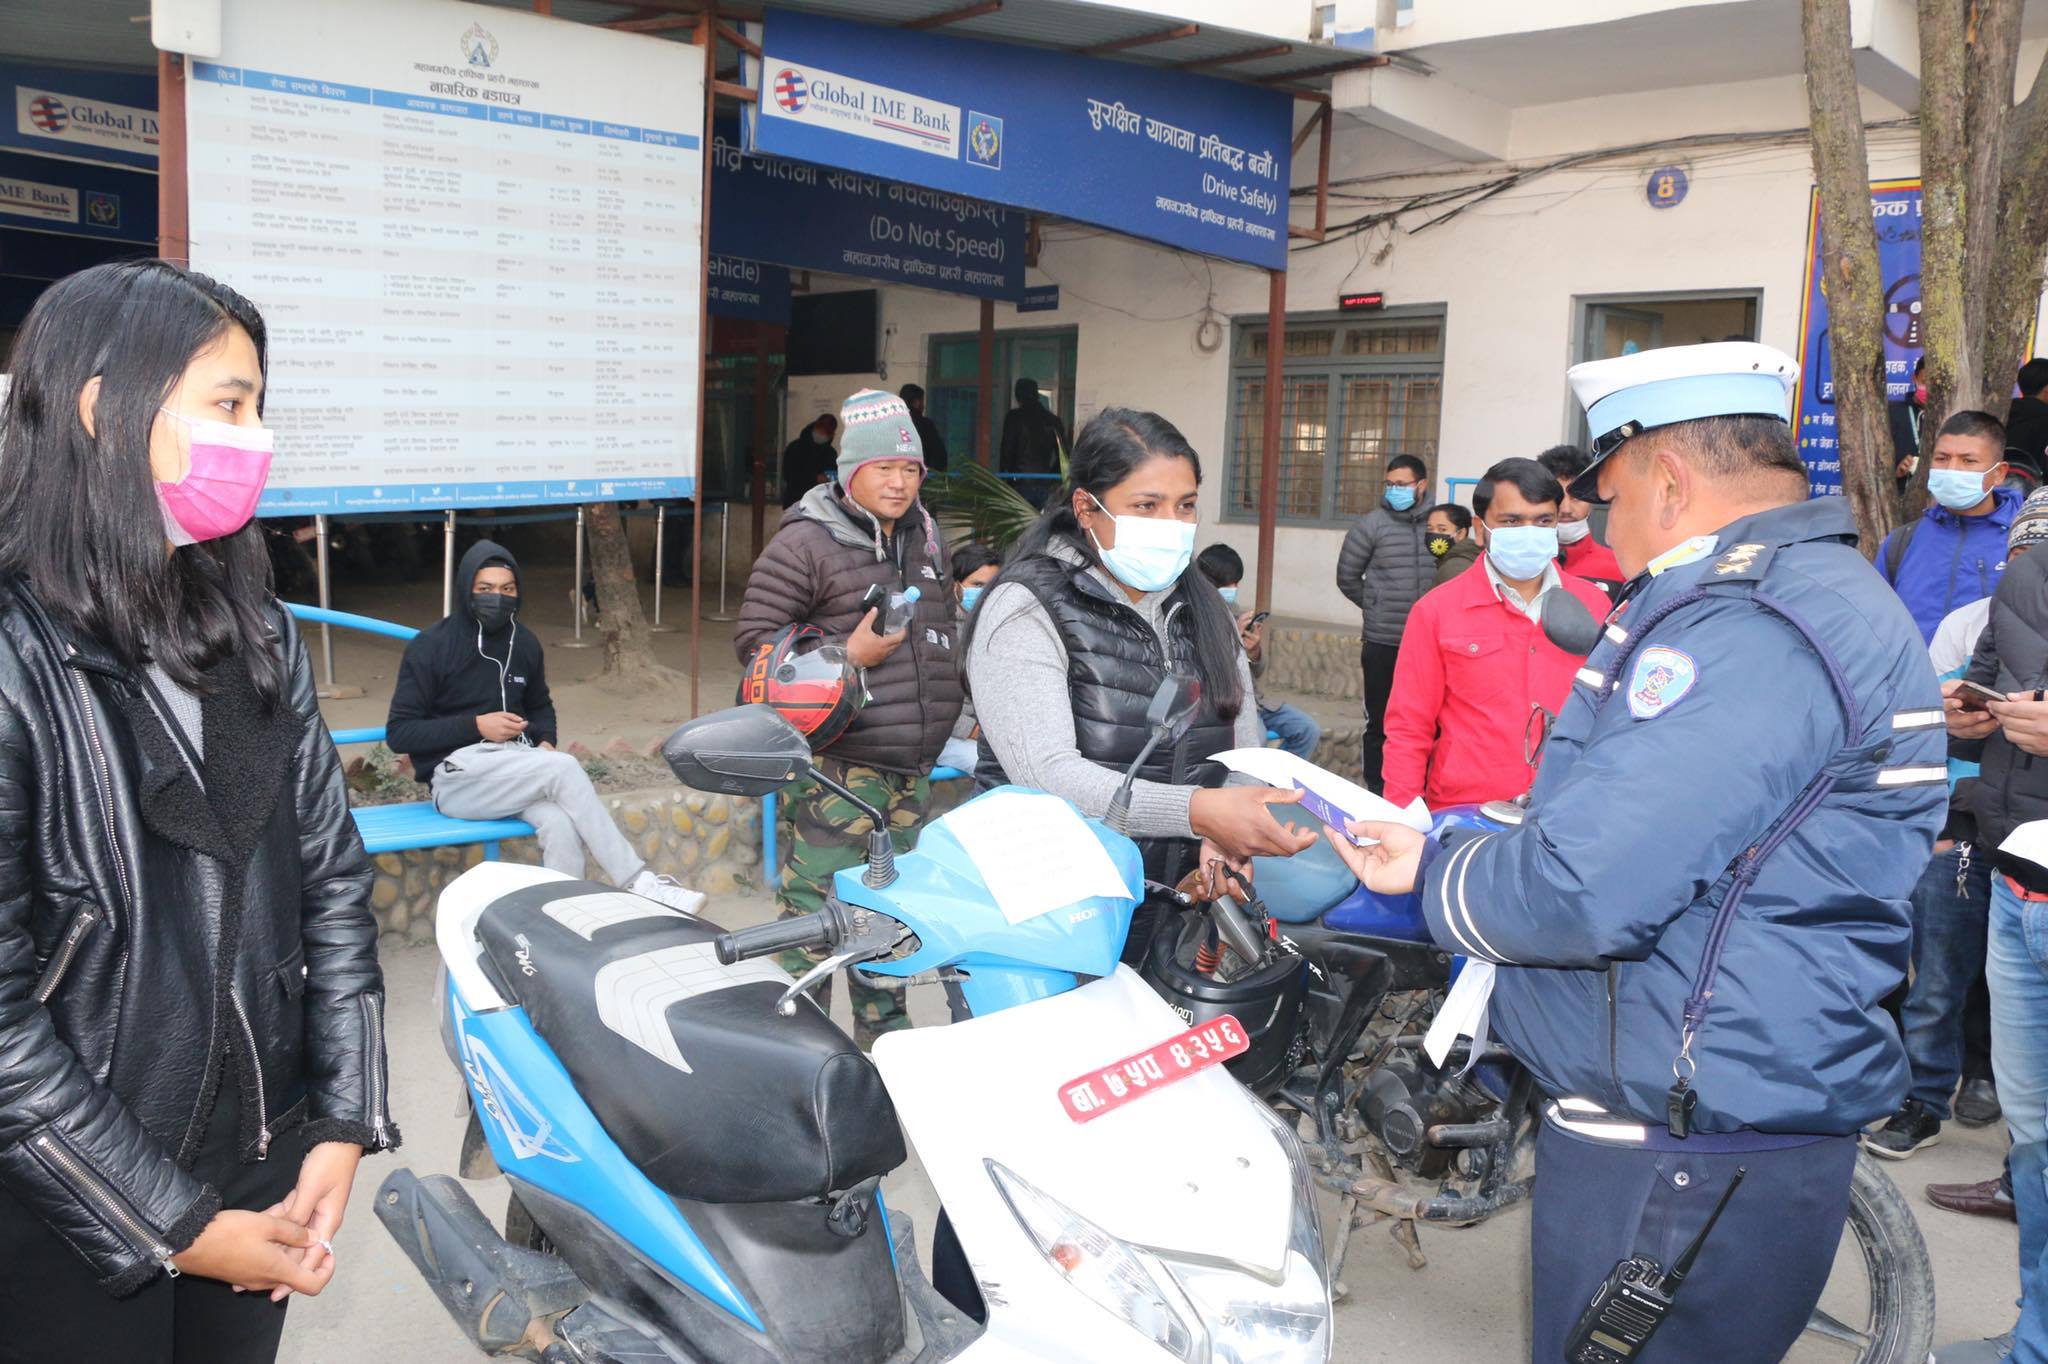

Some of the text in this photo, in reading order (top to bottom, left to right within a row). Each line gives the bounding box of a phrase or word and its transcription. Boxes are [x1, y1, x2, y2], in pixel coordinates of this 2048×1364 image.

[430, 79, 478, 99] नागरिक
[71, 106, 132, 131] Global
[811, 80, 951, 132] Global IME Bank
[1088, 98, 1142, 135] सुरक्षित
[1146, 118, 1196, 153] यात्रामा
[1199, 134, 1245, 171] प्रतिबद्ध
[32, 189, 70, 206] Bank
[1156, 196, 1199, 219] महानगरीय
[1202, 173, 1277, 216] (Drive Safely)
[870, 216, 1005, 262] (Do Not Speed)
[708, 257, 760, 284] ehicle)
[843, 249, 899, 271] महानगरीय
